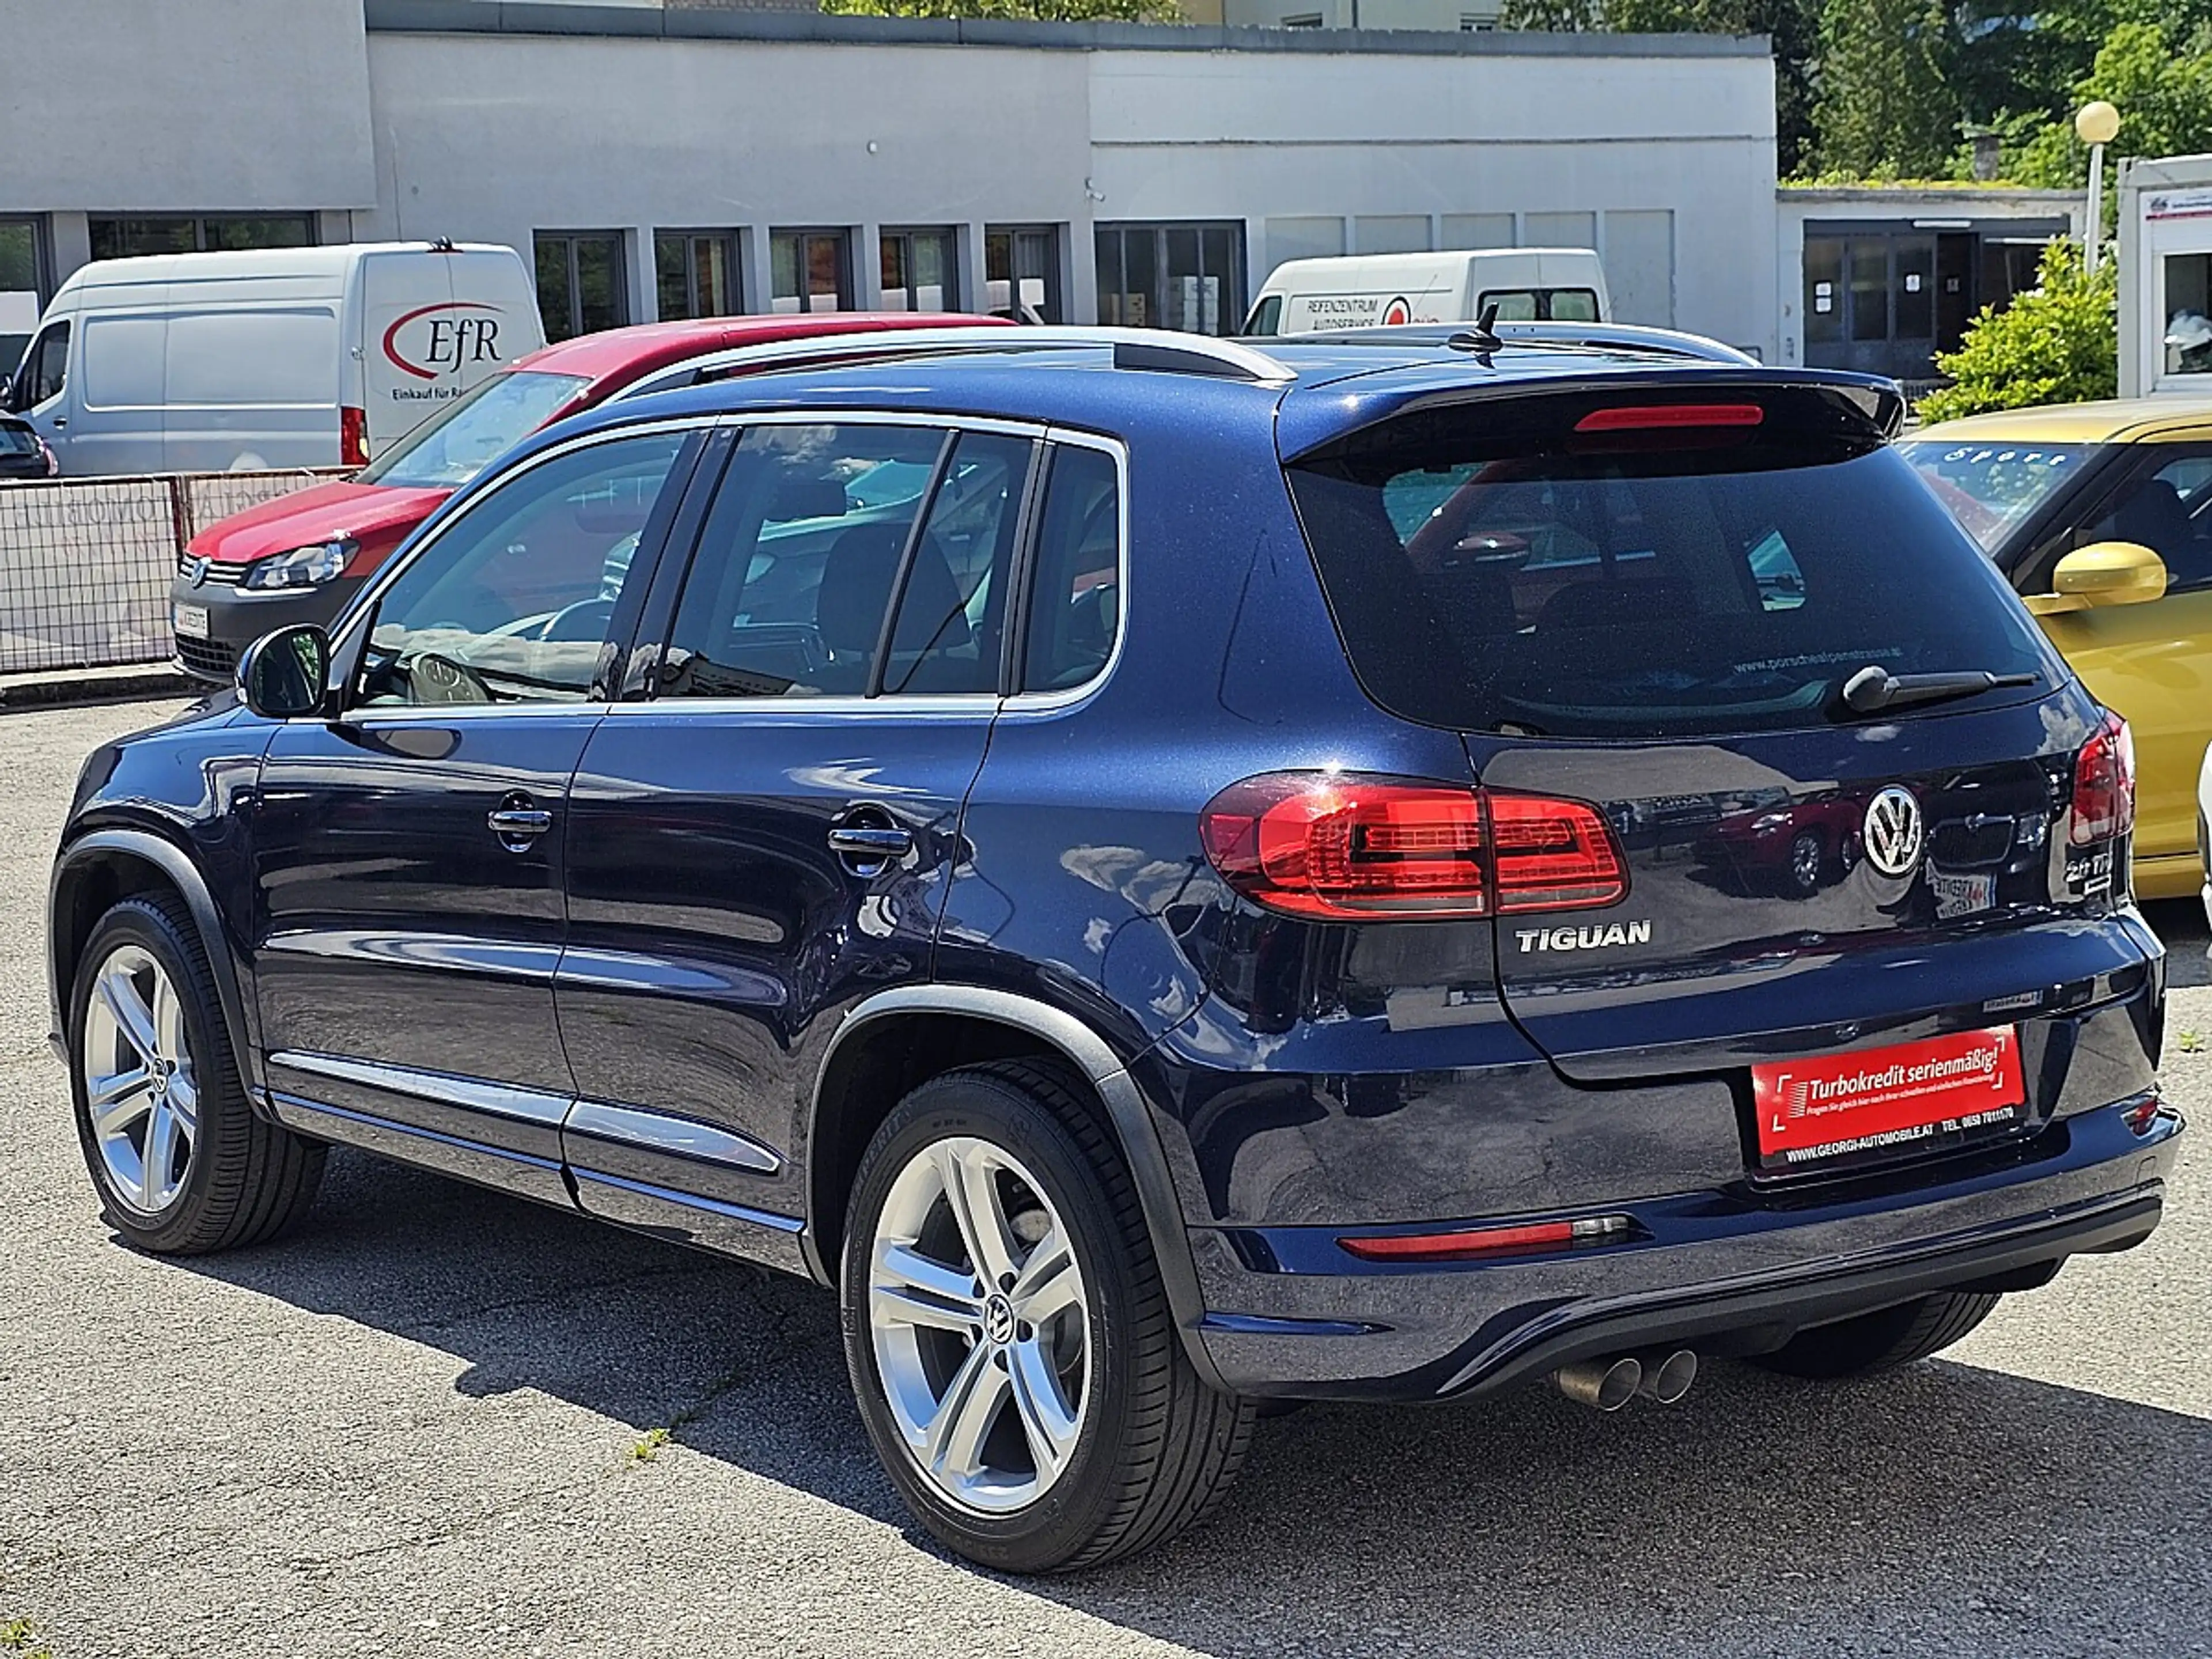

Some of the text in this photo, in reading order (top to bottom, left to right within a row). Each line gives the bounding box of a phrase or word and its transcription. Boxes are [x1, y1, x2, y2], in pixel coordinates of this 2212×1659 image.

[425, 319, 502, 373] EfR
[392, 388, 432, 400] Einkauf
[435, 388, 449, 399] für
[1944, 446, 2066, 466] Sport
[1515, 920, 1652, 953] TIGUAN
[1810, 1046, 1999, 1100] Turbokredit serienmäßig!
[1786, 1123, 1934, 1164] WWW.GEORGI-AUTOMOBILE.AT
